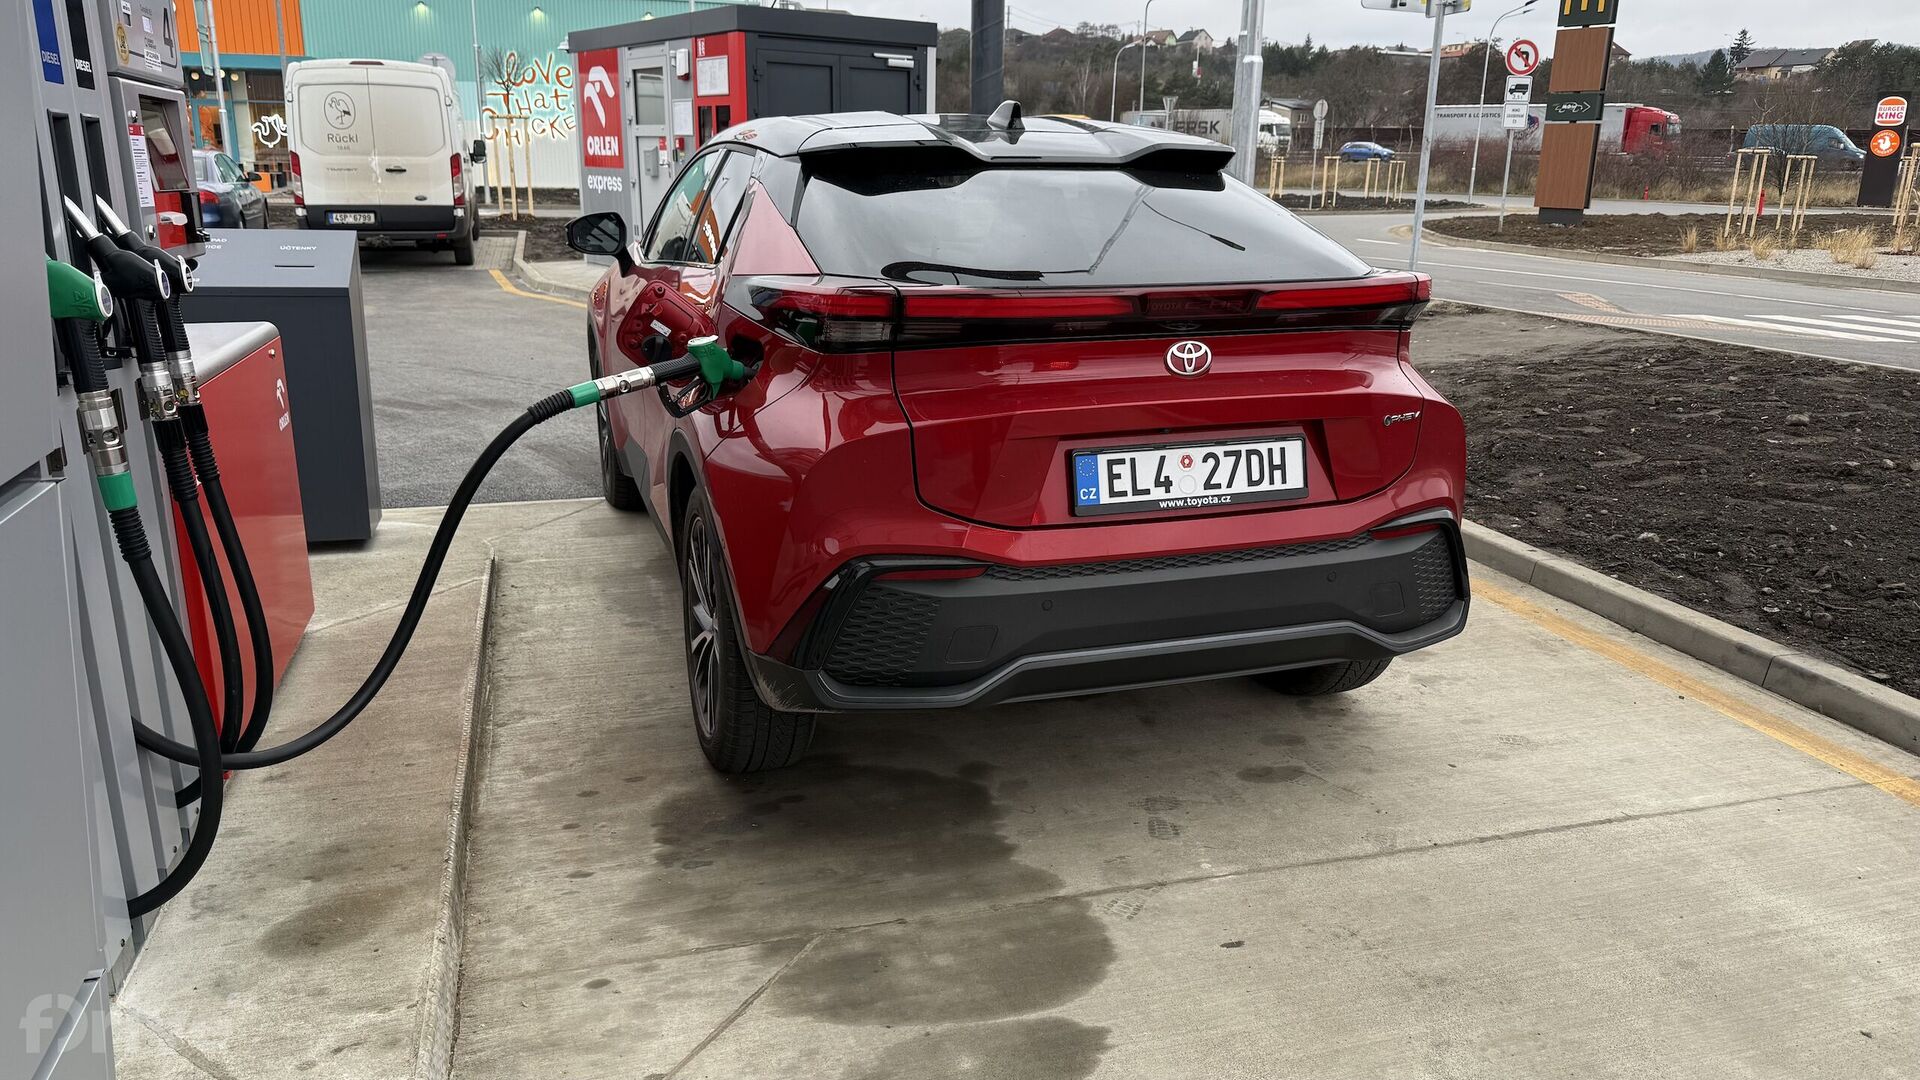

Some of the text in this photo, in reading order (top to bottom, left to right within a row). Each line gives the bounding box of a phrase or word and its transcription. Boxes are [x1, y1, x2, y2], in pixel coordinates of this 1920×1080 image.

[163, 7, 174, 58] 4
[41, 50, 61, 66] DIESEL
[75, 58, 92, 73] DIESEL
[586, 135, 620, 157] ORLEN
[587, 174, 623, 194] express
[334, 214, 373, 222] 4SP 6799
[1106, 446, 1288, 498] EL4 27DH
[1080, 487, 1098, 500] CZ
[1158, 494, 1232, 509] www.toyota.cz
